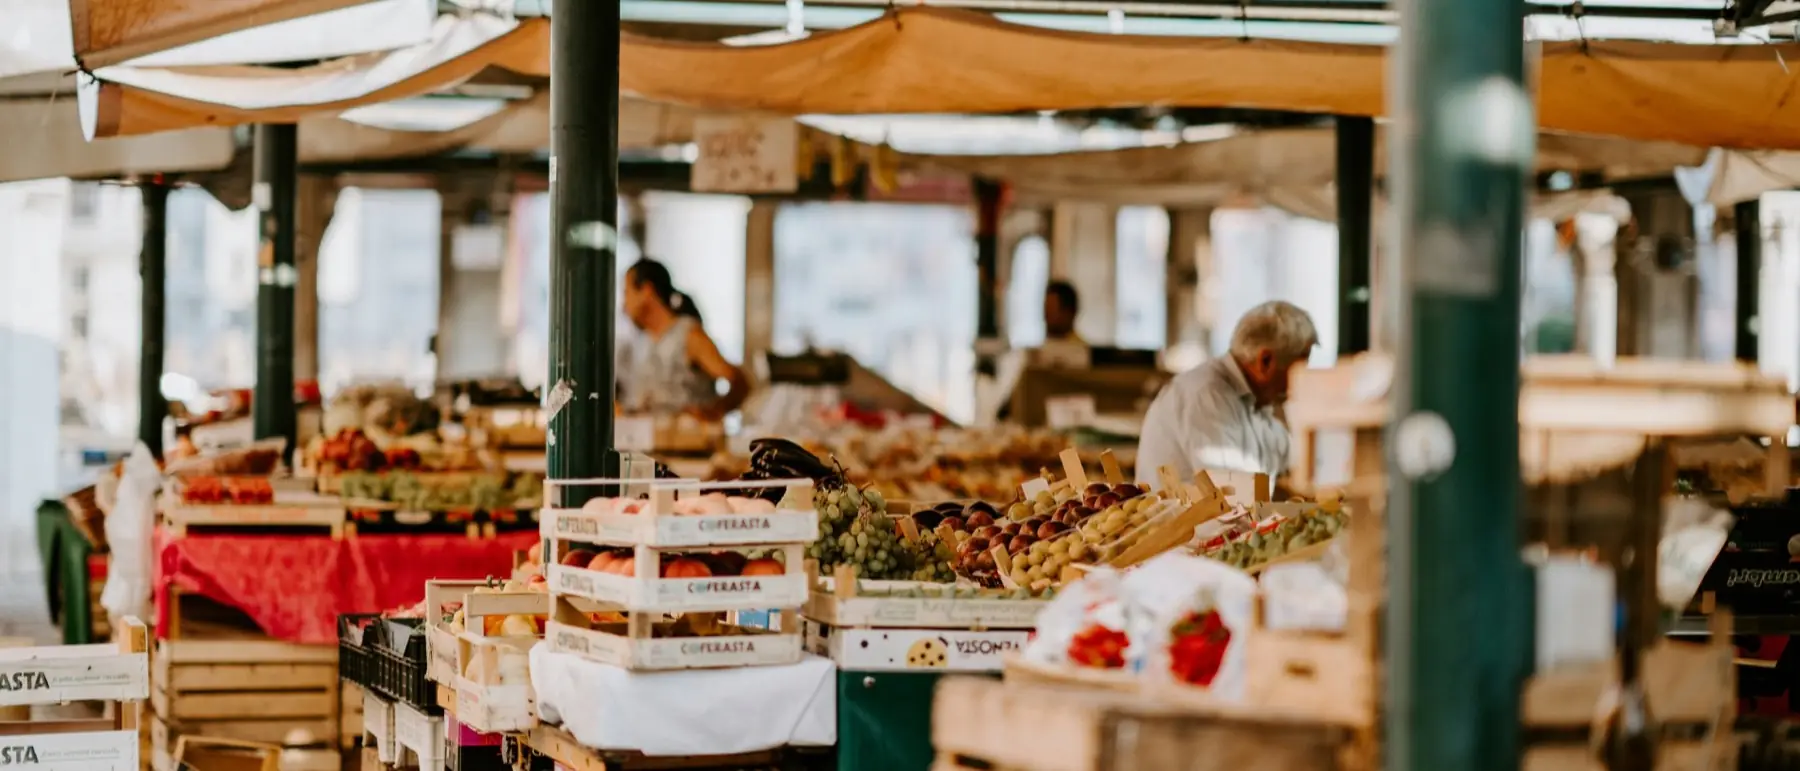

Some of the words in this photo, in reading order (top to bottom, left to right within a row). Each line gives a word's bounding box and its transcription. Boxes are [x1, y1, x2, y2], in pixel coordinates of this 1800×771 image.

[697, 517, 771, 531] COFERASTA
[687, 580, 762, 594] COFERASTA
[680, 640, 756, 655] COFERASTA
[0, 745, 39, 765] STA
